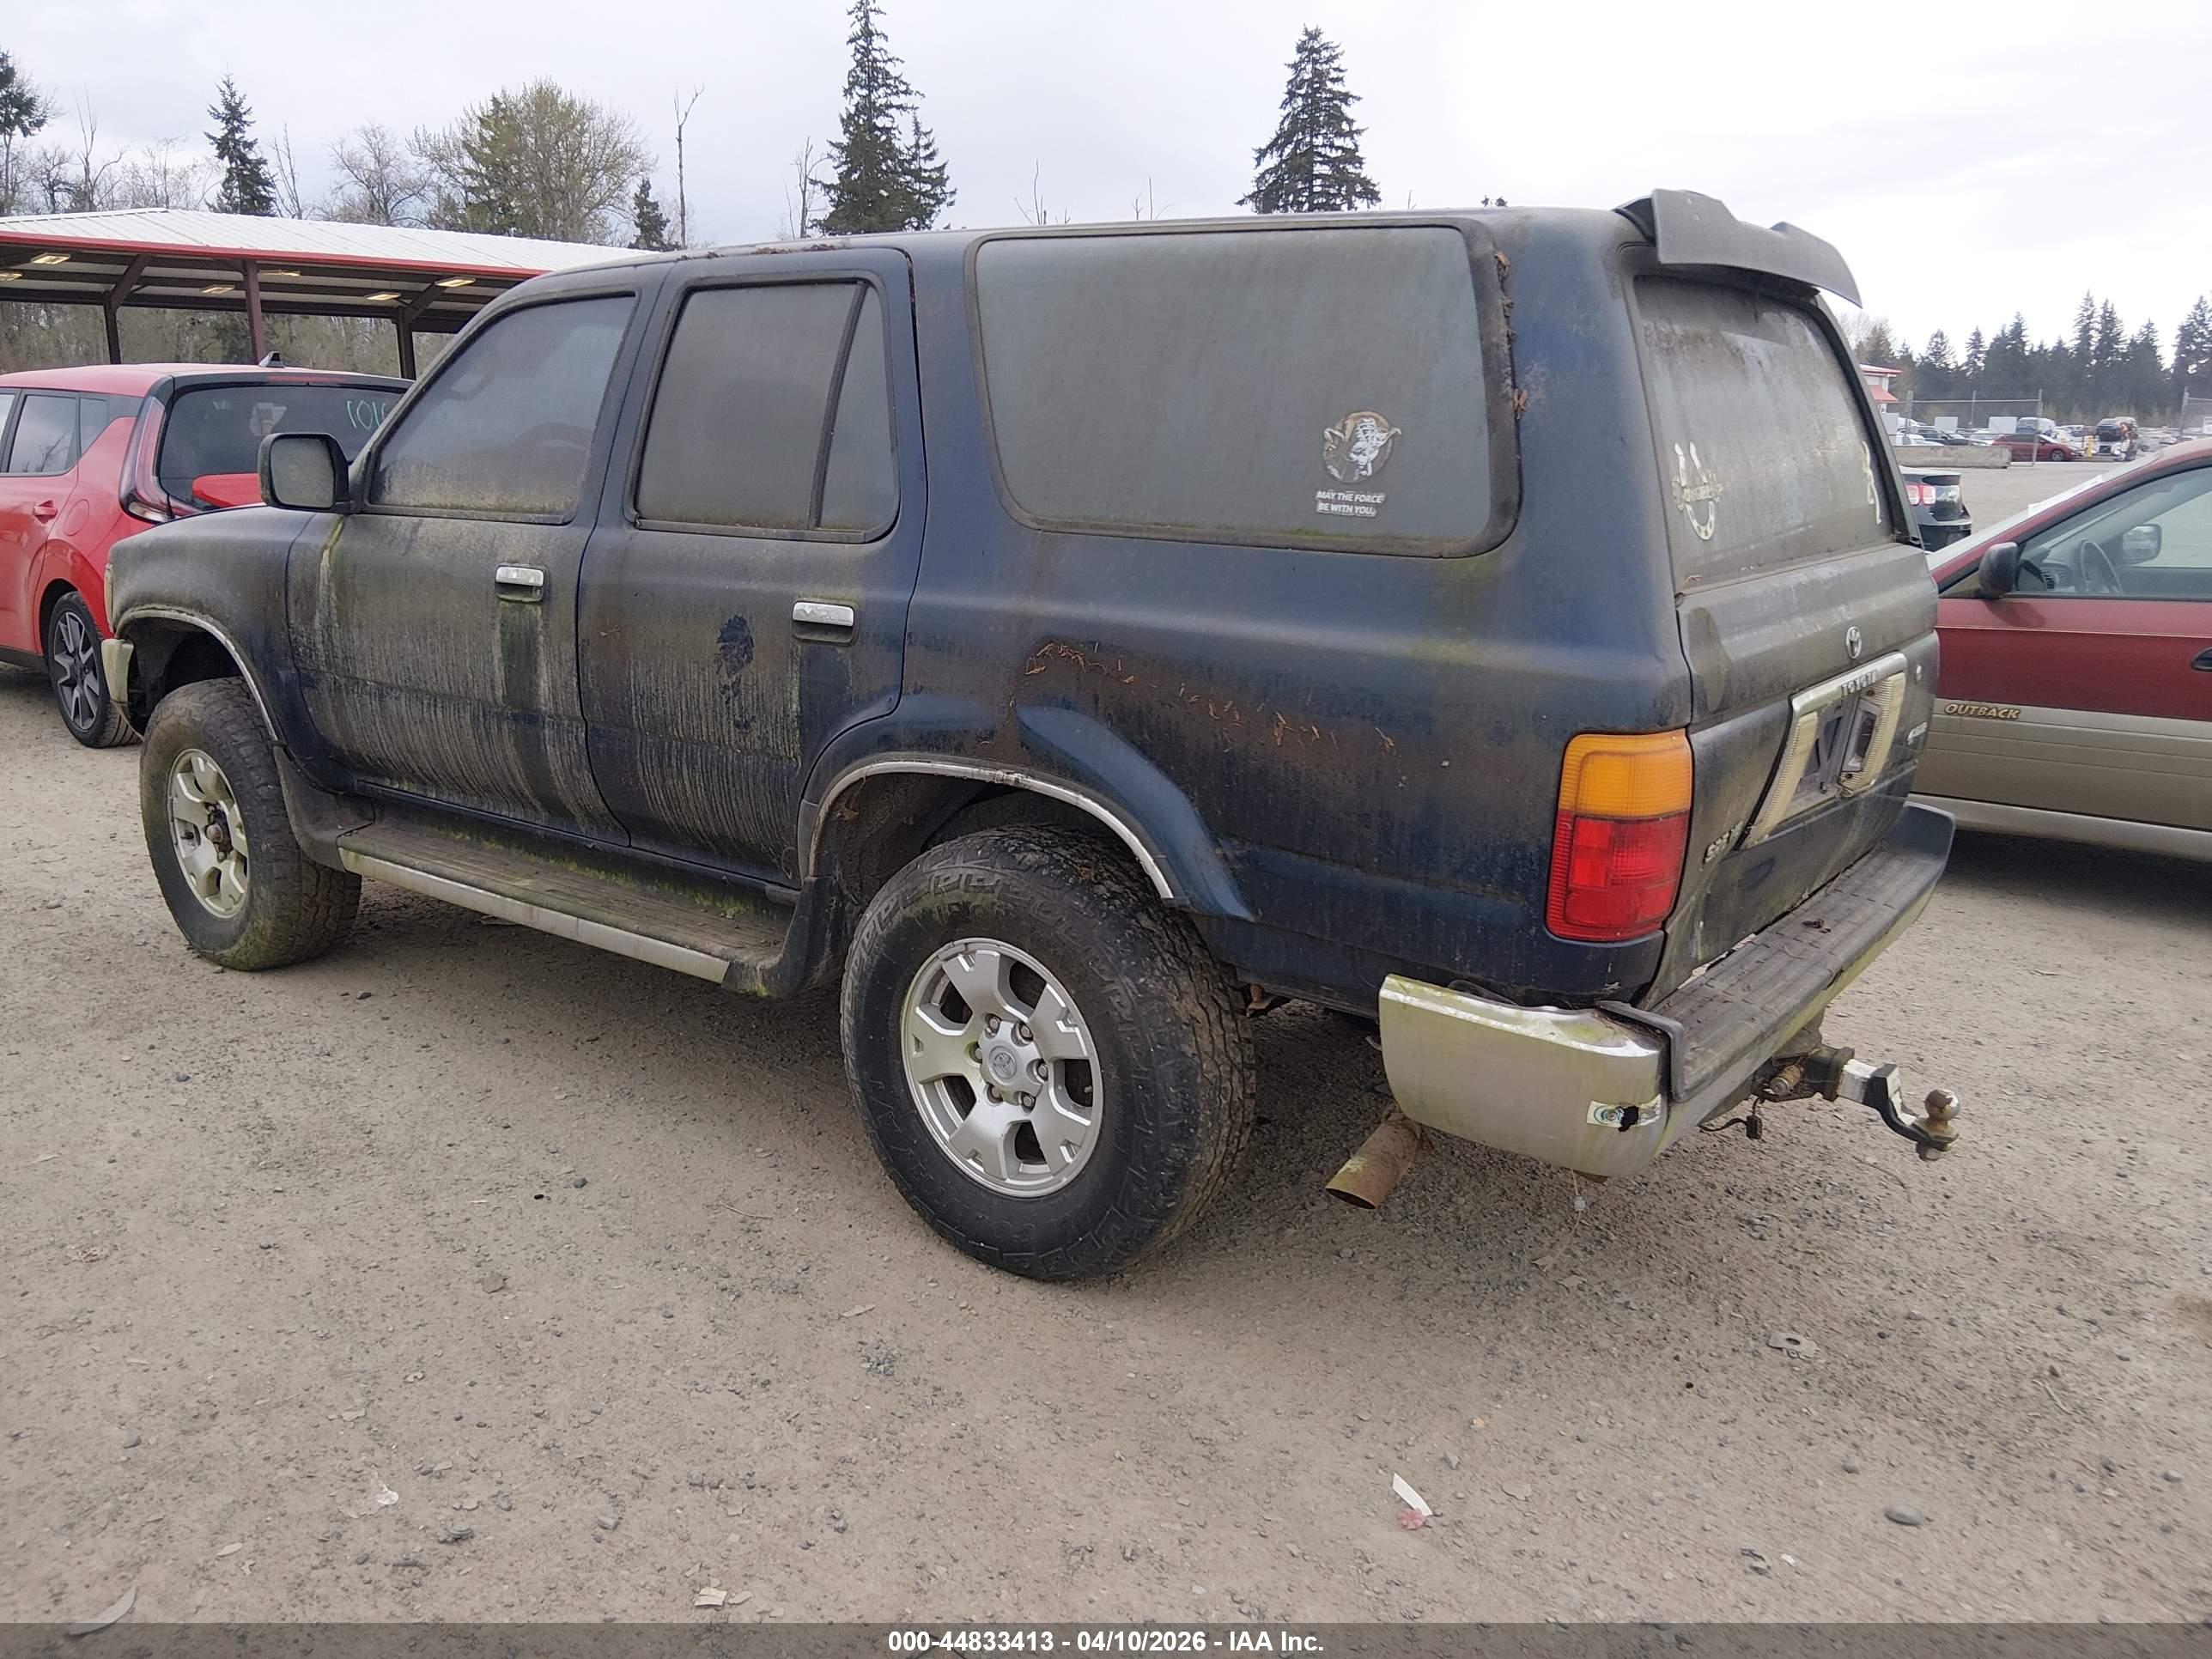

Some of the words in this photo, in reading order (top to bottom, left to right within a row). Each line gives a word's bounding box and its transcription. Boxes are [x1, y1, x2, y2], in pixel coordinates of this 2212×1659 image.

[1316, 490, 1336, 500] MAY
[1336, 492, 1354, 501] THE
[1354, 494, 1383, 504] FORCE
[1317, 502, 1330, 512] BE
[1330, 503, 1353, 514] WITH
[1944, 703, 2021, 720] OUTBACK
